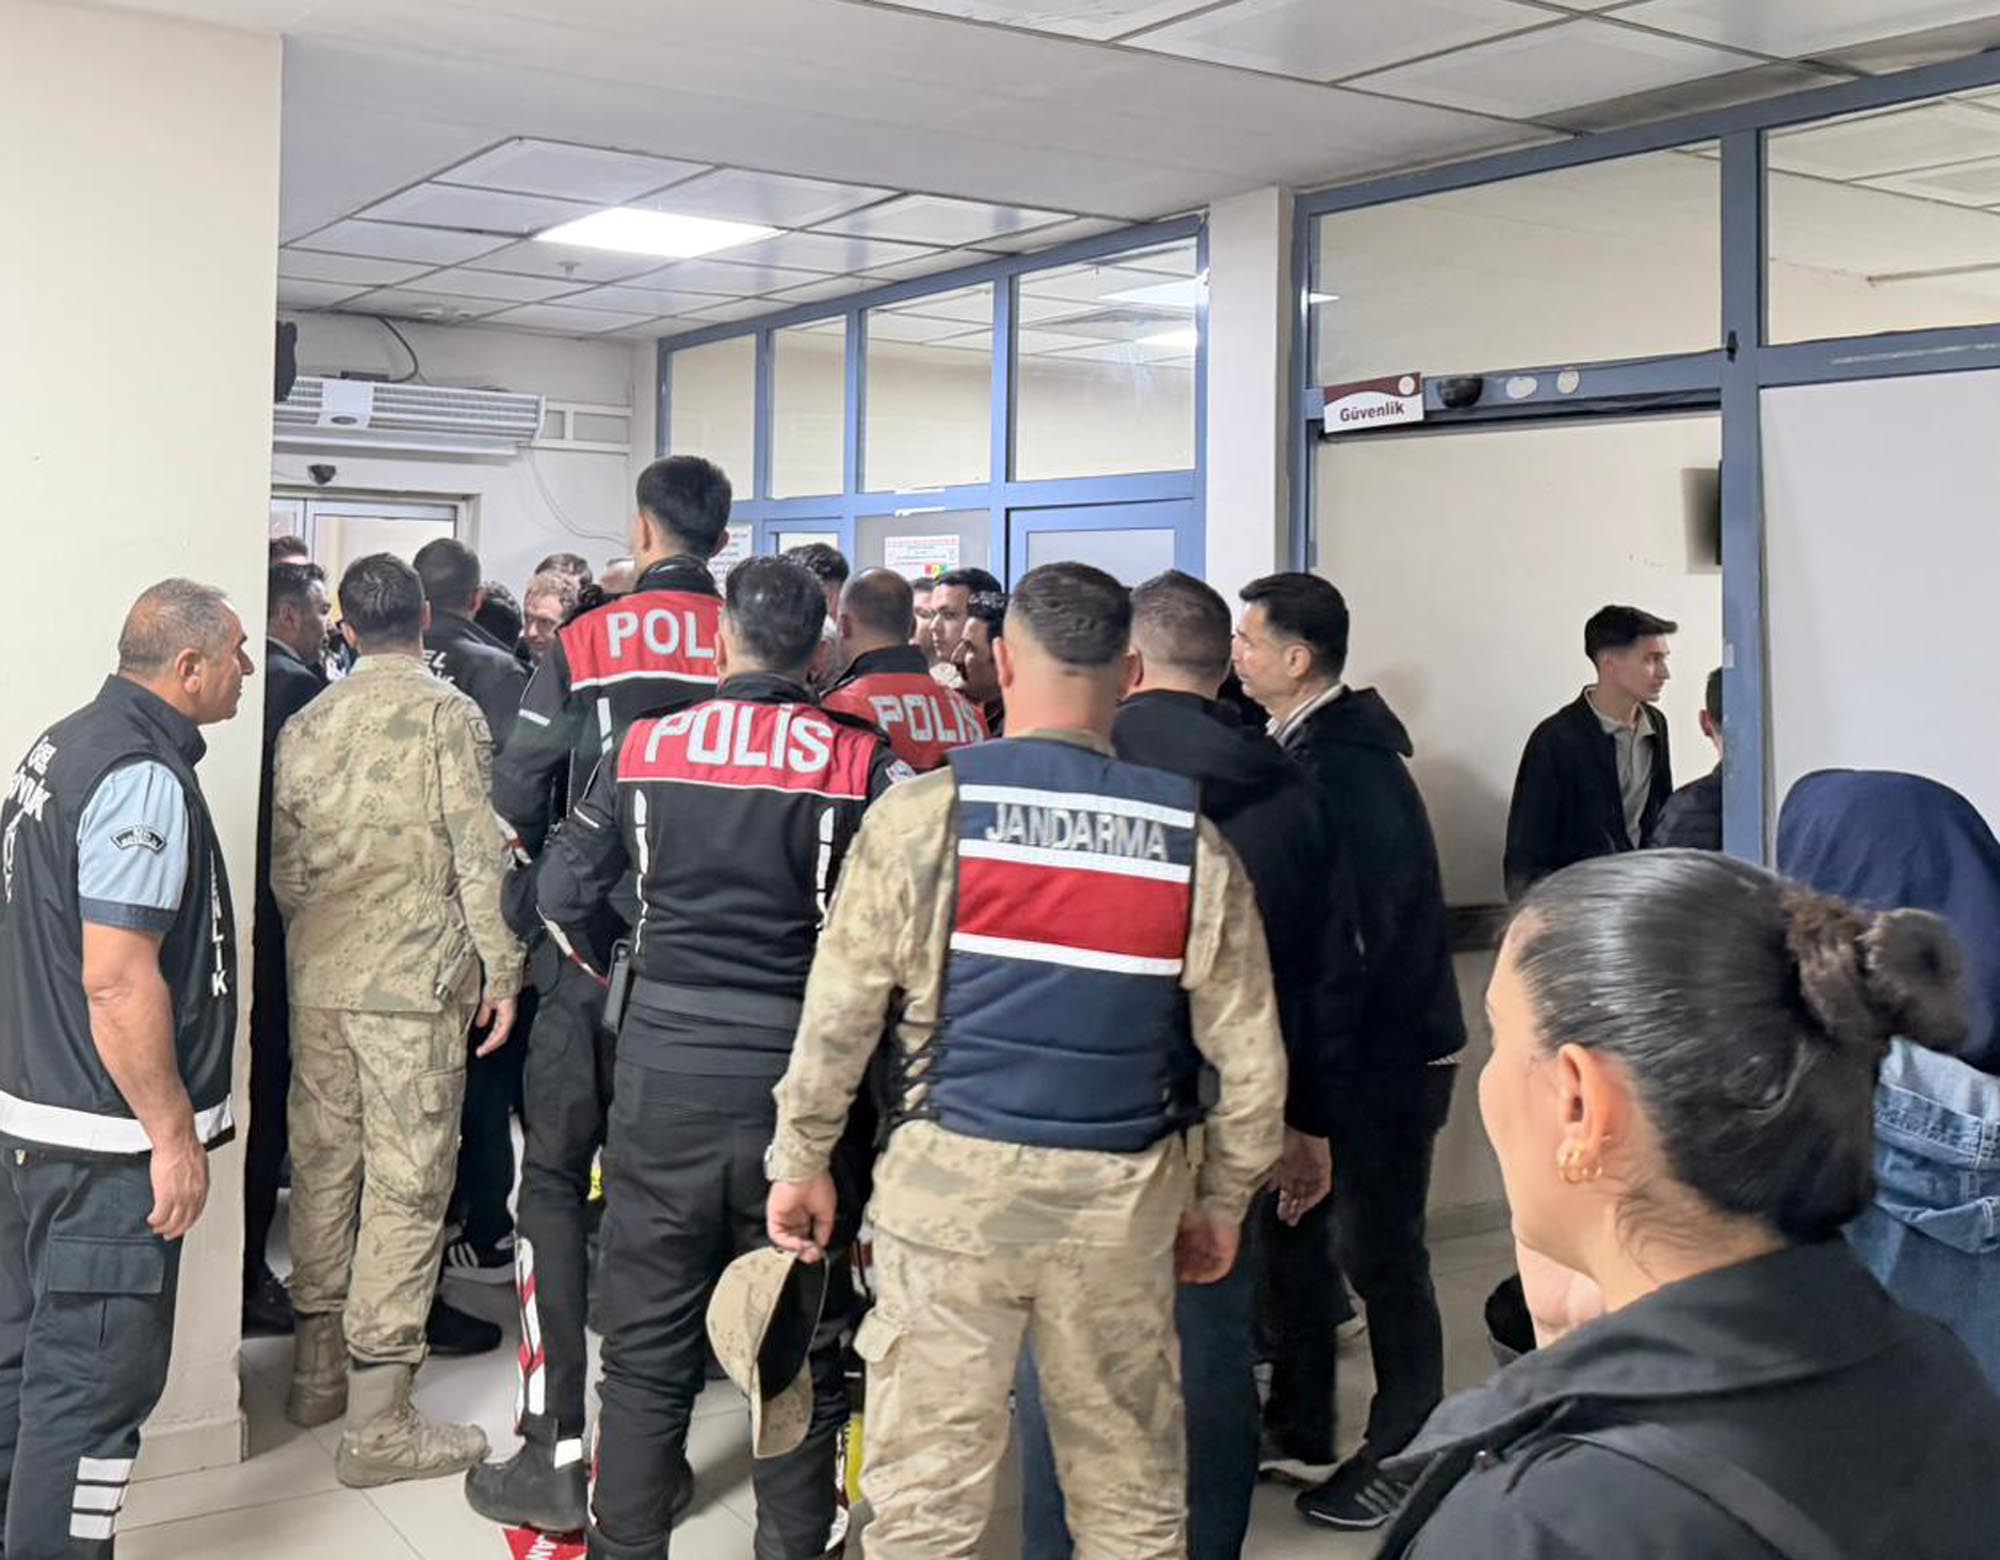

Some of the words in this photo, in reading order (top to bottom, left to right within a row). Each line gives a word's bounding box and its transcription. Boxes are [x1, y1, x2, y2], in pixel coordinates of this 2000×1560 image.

[1340, 401, 1405, 422] Güvenlik
[606, 609, 715, 658] POL
[985, 803, 1168, 862] JANDARMA
